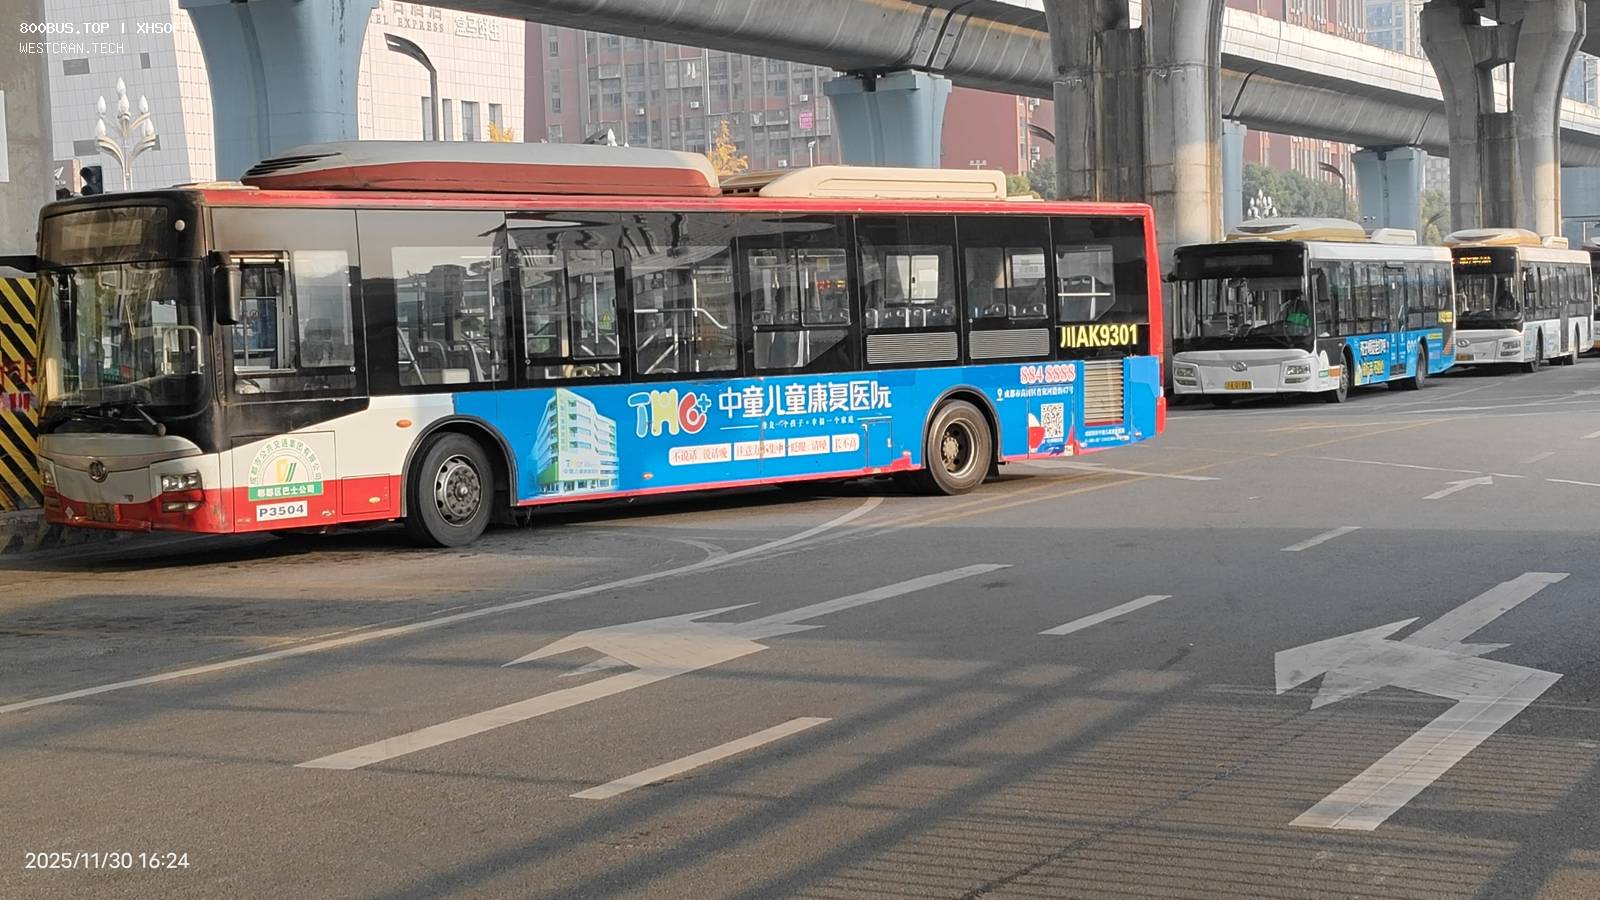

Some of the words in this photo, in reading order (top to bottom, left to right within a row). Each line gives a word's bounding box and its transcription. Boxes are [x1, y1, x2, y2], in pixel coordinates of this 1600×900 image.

[397, 17, 445, 33] EXPRESS
[718, 380, 893, 418] 中童儿童康复医院
[259, 504, 305, 518] P3504
